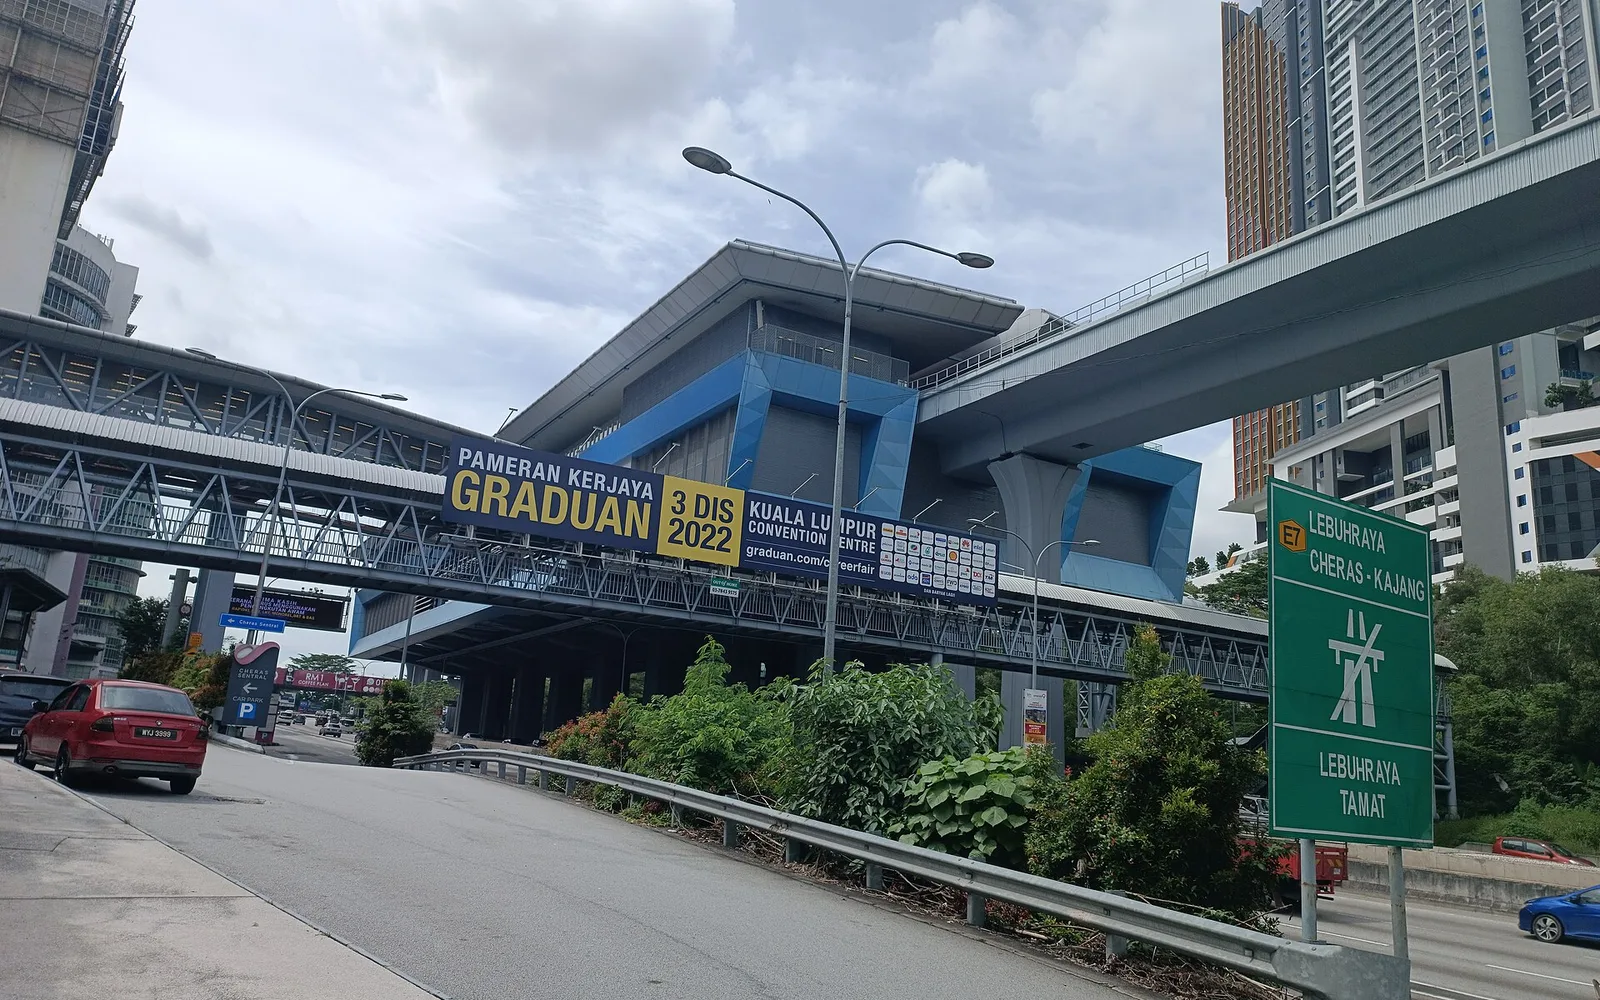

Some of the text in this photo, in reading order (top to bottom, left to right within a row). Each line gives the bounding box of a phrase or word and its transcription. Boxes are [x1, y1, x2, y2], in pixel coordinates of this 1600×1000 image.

[458, 446, 654, 501] PAMERAN KERJAYA
[450, 468, 652, 540] GRADUAN
[670, 489, 735, 524] 3 DIS
[749, 500, 804, 528] KUALA
[666, 517, 733, 553] 2022
[748, 519, 827, 547] CONVENTION
[837, 536, 876, 555] ENTRE
[1282, 525, 1301, 547] E7
[1309, 510, 1386, 554] LEBUHRAYA
[745, 544, 876, 576] graduan.com/ceerfair
[1310, 549, 1364, 585] CHERAS
[1374, 568, 1425, 603] KAJANG
[240, 602, 286, 613] PENNGKUTAN
[250, 595, 298, 606] TIMA KASIH
[239, 619, 279, 629] Cheras Sentral
[239, 702, 254, 718] P
[1319, 751, 1401, 786] LEBUHRAYA
[1339, 788, 1386, 819] TAMAT
